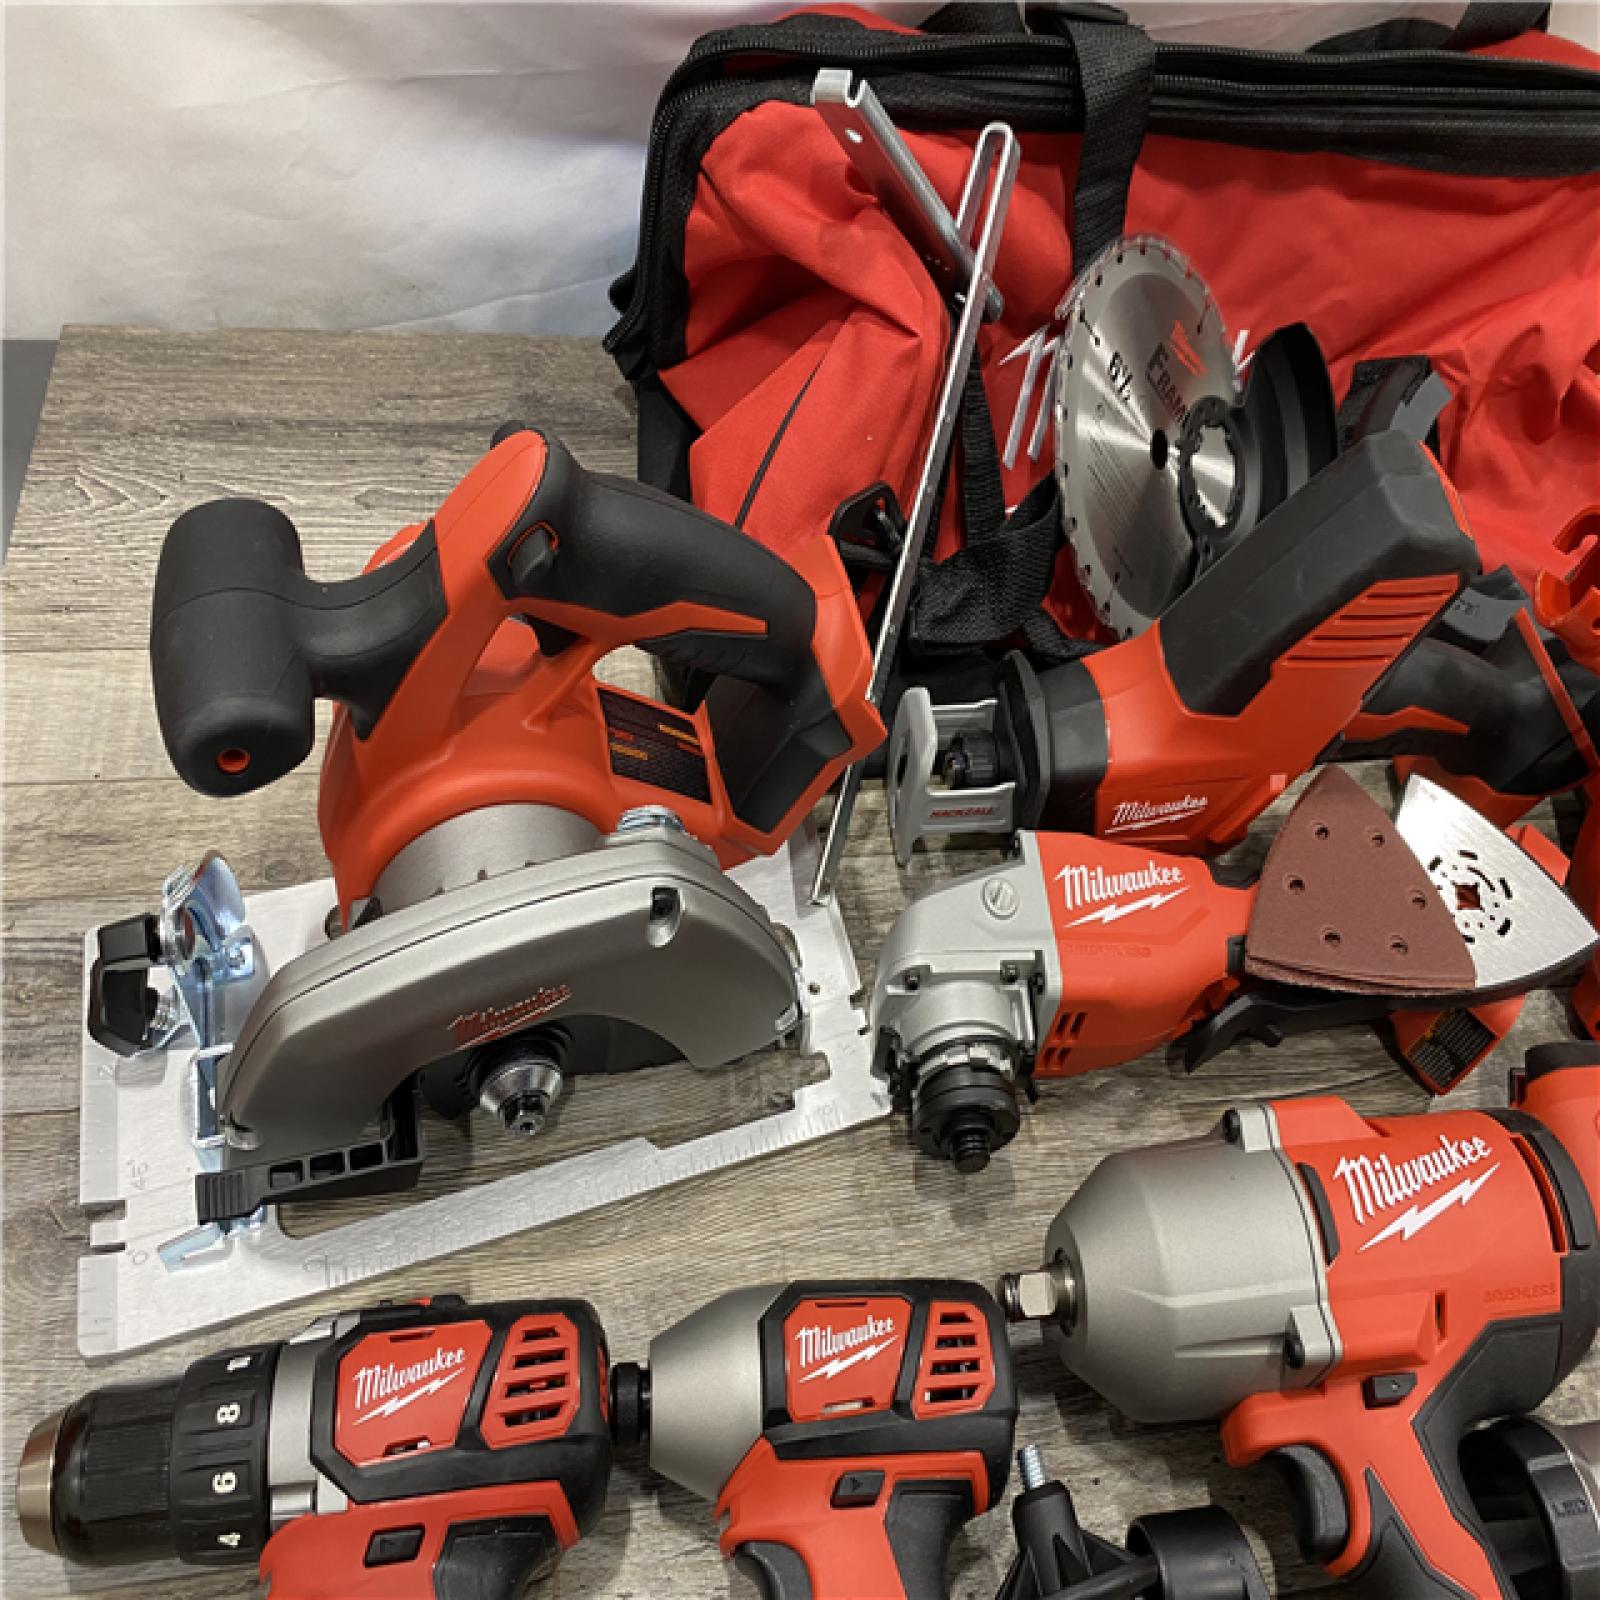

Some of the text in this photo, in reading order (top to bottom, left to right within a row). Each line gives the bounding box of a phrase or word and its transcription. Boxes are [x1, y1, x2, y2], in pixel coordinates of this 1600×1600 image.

[1111, 795, 1208, 825] Milwaukee
[1054, 859, 1184, 910] Milwaukee
[448, 983, 572, 1044] Milwaukee
[1332, 1133, 1492, 1225] Milwaukee
[794, 1314, 896, 1368] Milwaukee
[352, 1347, 466, 1409] Milwaukee
[216, 1402, 241, 1425] 8
[212, 1471, 238, 1494] 6
[217, 1532, 241, 1547] 4
